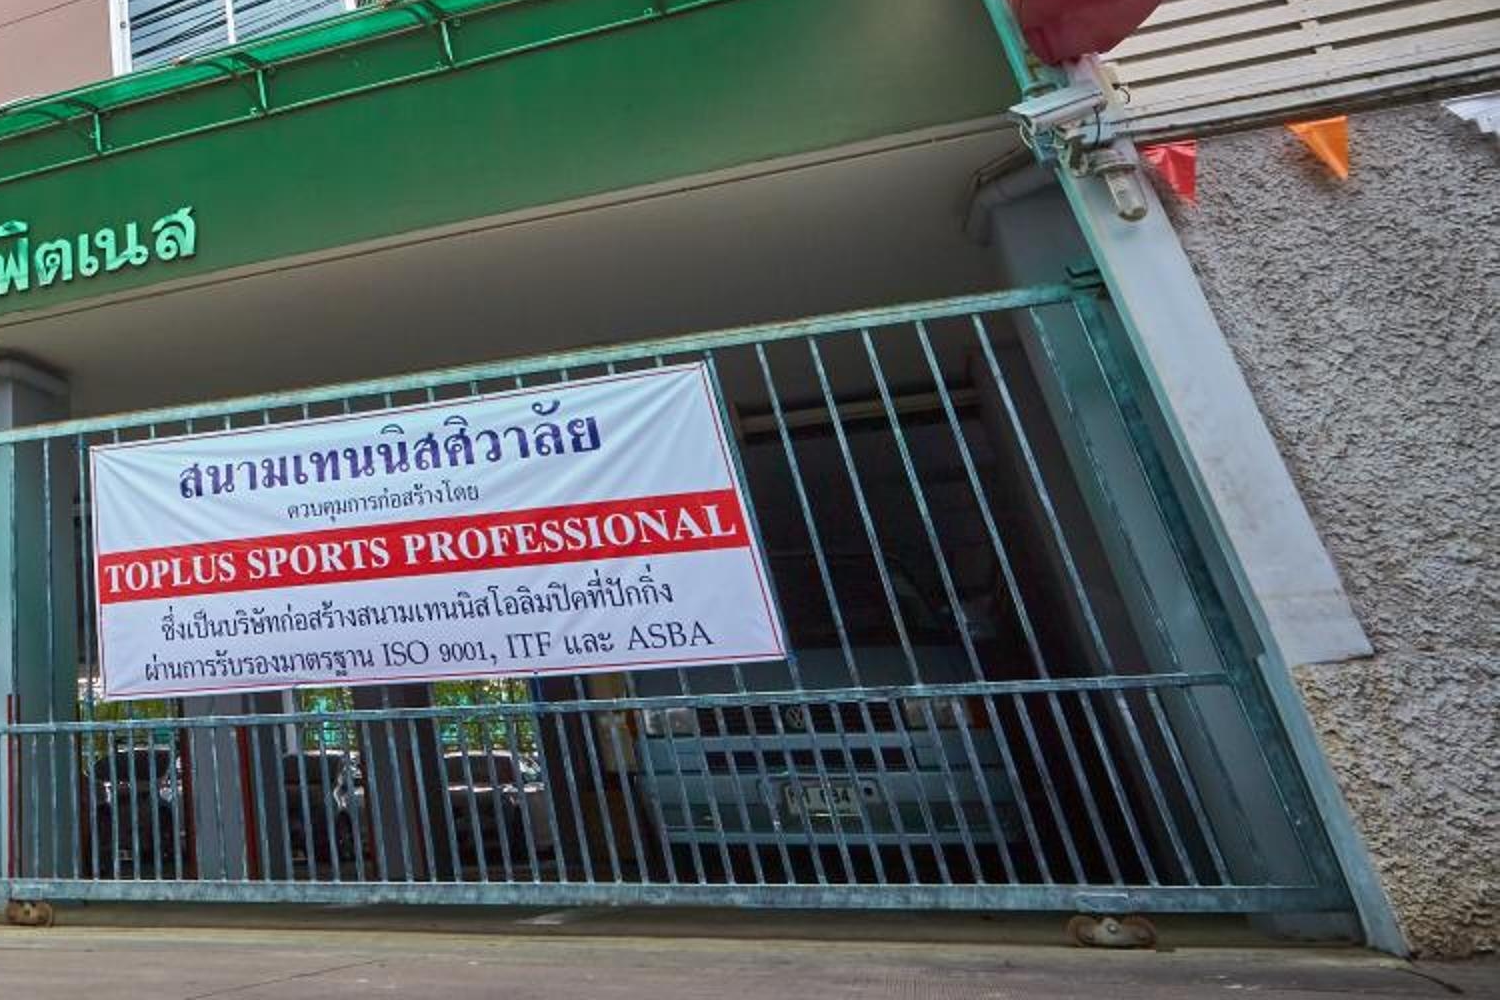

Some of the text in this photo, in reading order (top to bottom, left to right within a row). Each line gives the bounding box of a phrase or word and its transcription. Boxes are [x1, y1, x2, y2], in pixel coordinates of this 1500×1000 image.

[179, 400, 602, 499] สนามเทนนิสศิวาลัย
[287, 479, 480, 522] ควบคุมการก่อสร้างโดย
[104, 504, 738, 593] TOPLUS SPORTS PROFESSIONAL
[161, 564, 674, 642] ซึ่งเป็นบริษัทก่อสร้างสนามเทนนิสโอลิมปิคที่ปักกิ่ง
[145, 619, 715, 682] ผ่านการรับรองมาตรฐาน ISO 9001, ITF และ ASBA
